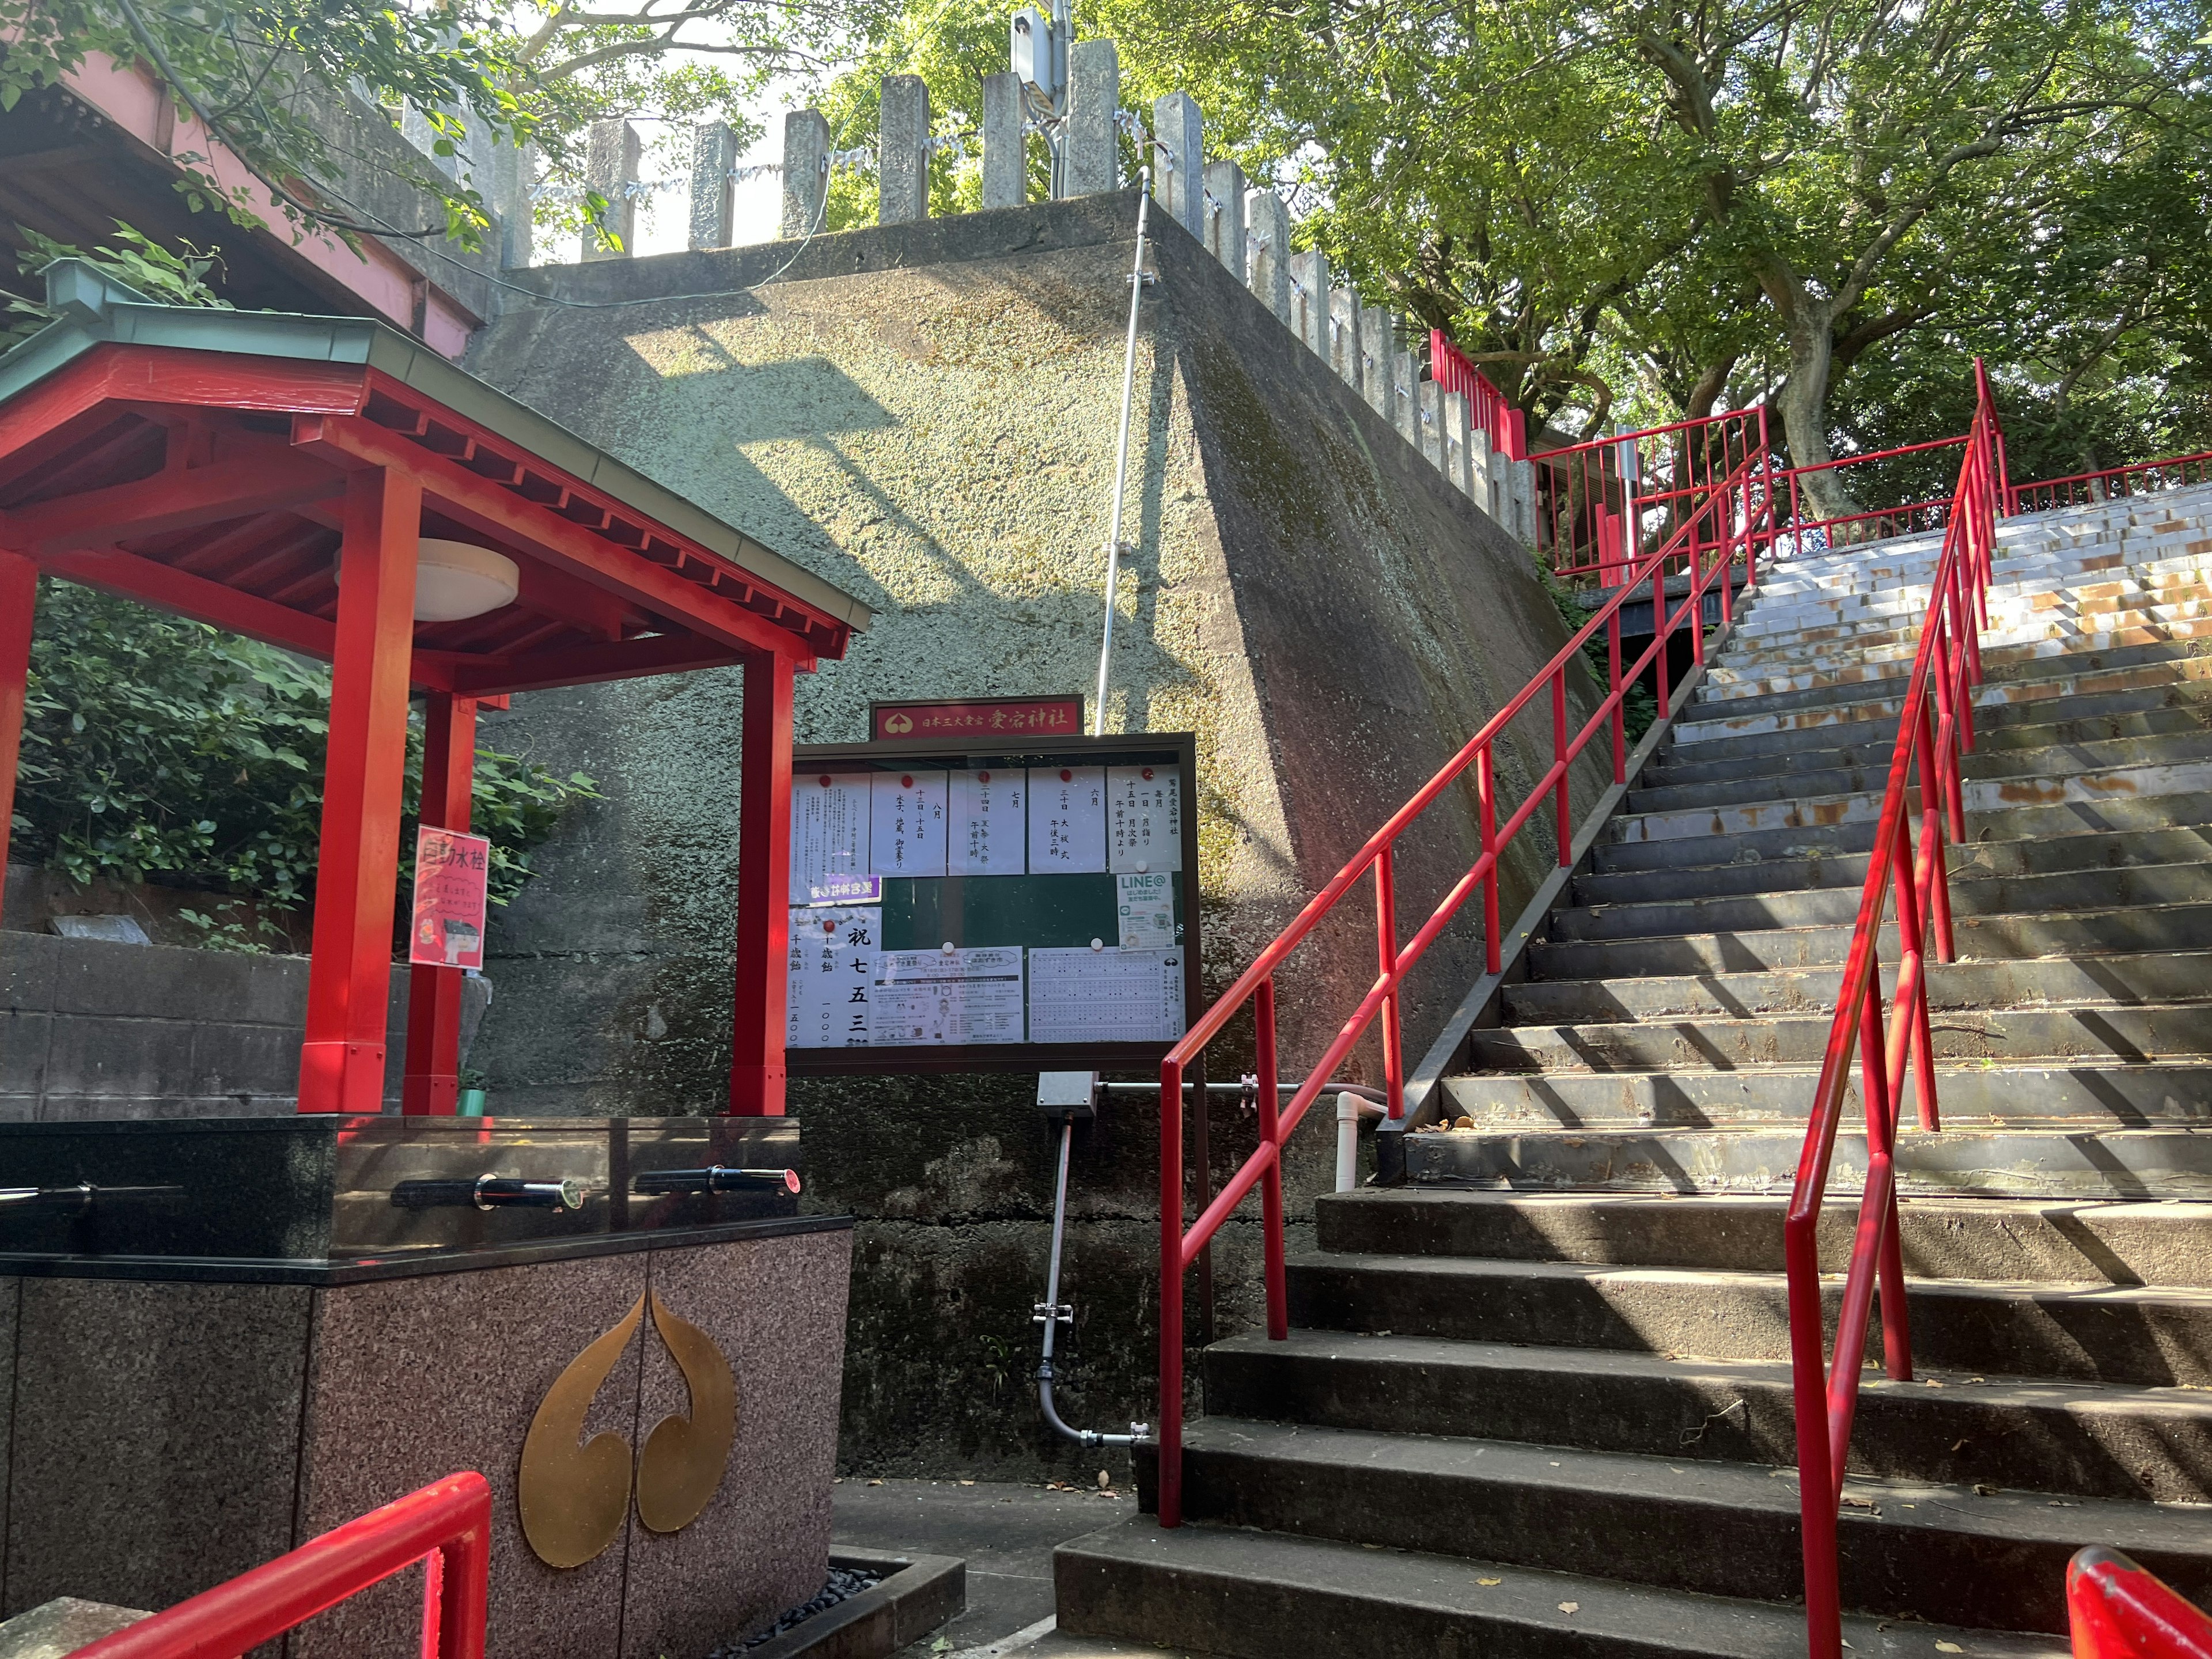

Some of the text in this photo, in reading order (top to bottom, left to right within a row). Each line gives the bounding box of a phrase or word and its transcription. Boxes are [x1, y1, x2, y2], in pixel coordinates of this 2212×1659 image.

[922, 709, 1069, 730] 日本三大愛宕 愛宕神社
[933, 802, 942, 819] 八月
[1012, 791, 1020, 808] 七月
[1090, 789, 1099, 806] 六月
[1154, 790, 1164, 808] 毎月
[1127, 781, 1137, 847] 十五日 月次祭
[969, 821, 979, 858] 午前十時
[1050, 820, 1059, 856] 午後三時
[1115, 800, 1124, 856] 午前十時より
[423, 838, 485, 870] 自動水栓
[1122, 875, 1165, 888] LINE@
[790, 934, 801, 971] 千歳飴
